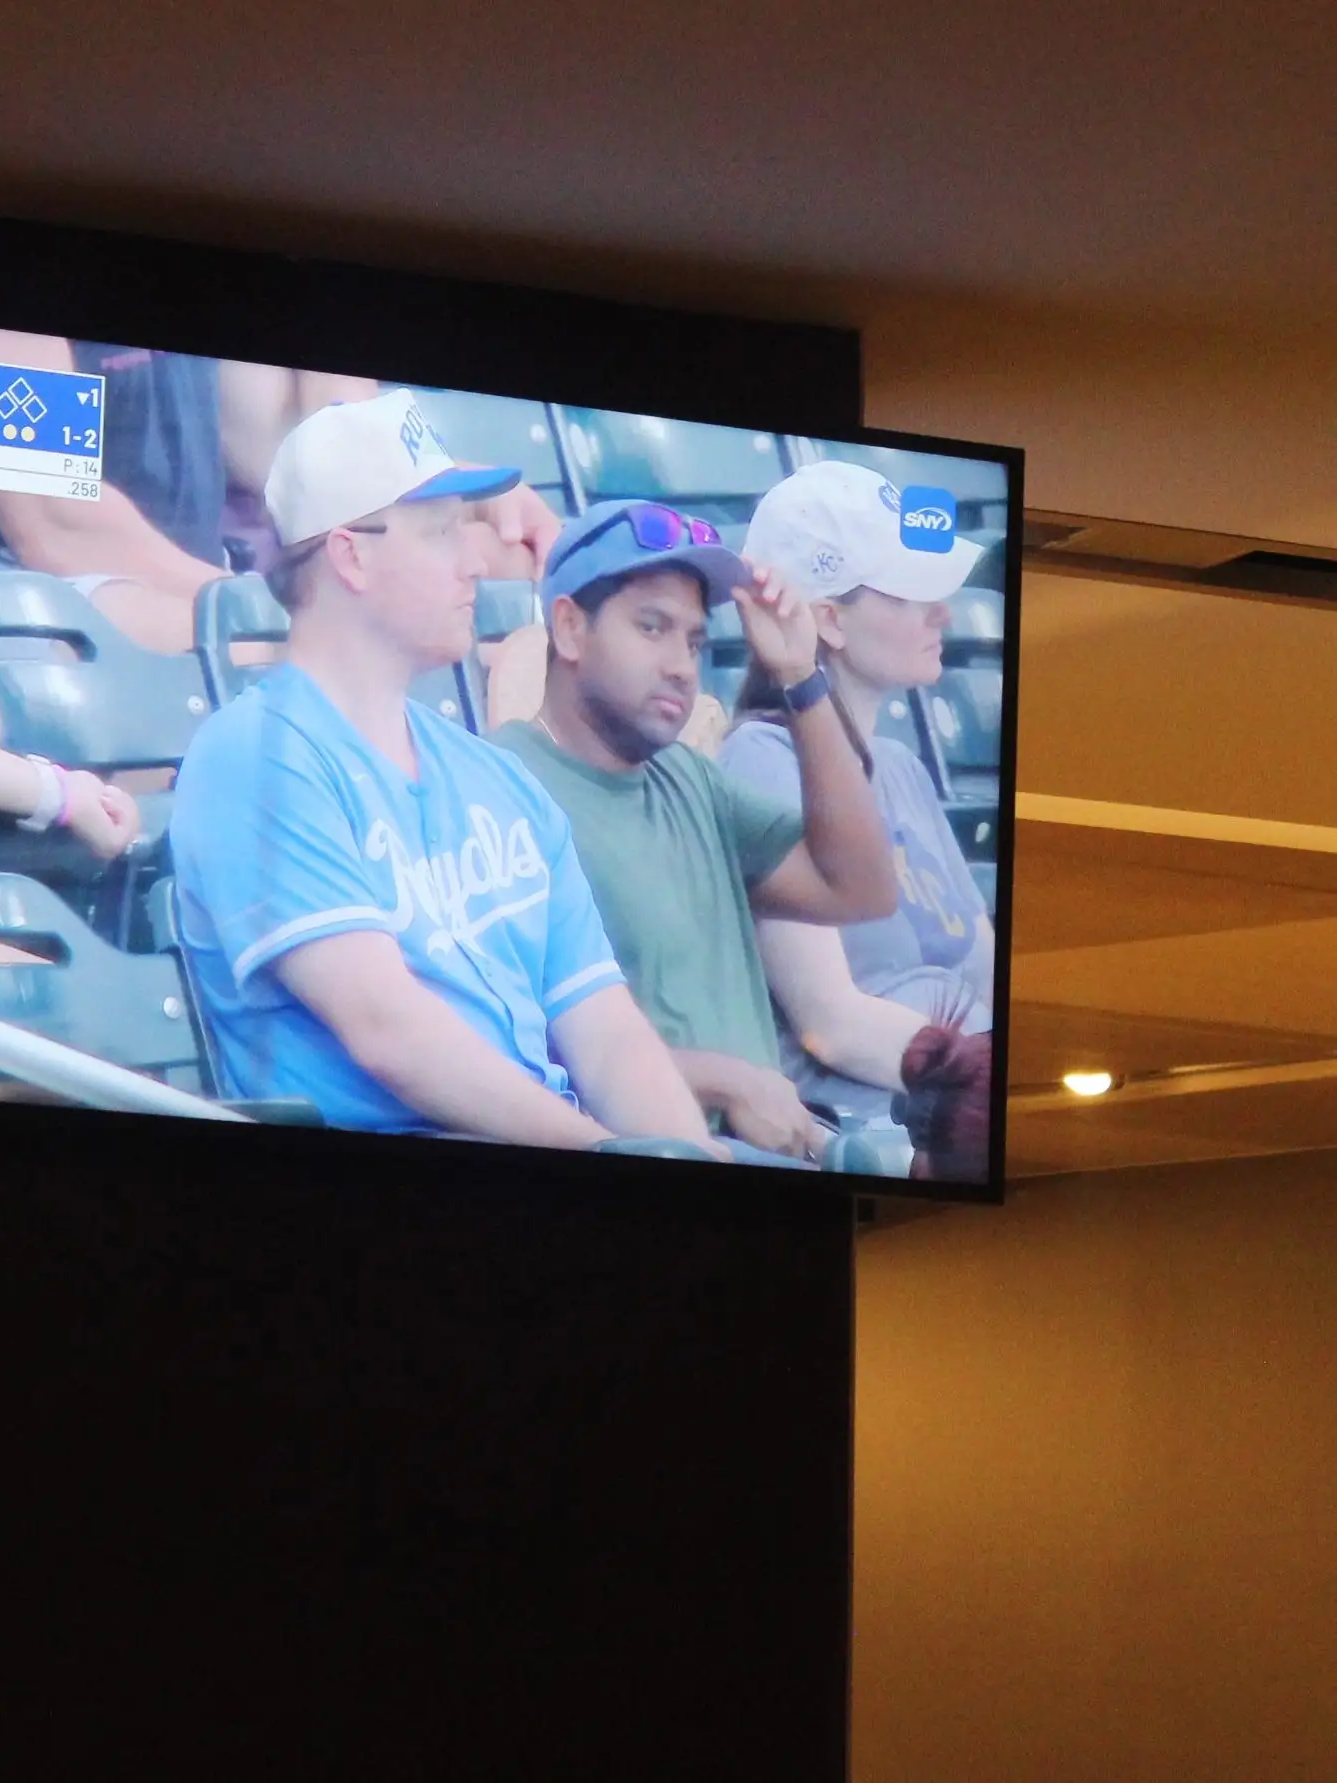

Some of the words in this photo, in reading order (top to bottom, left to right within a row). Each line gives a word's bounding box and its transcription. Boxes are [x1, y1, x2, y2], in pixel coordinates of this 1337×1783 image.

[90, 387, 100, 408] 1
[62, 425, 98, 449] 1-2
[903, 508, 948, 531] SNY
